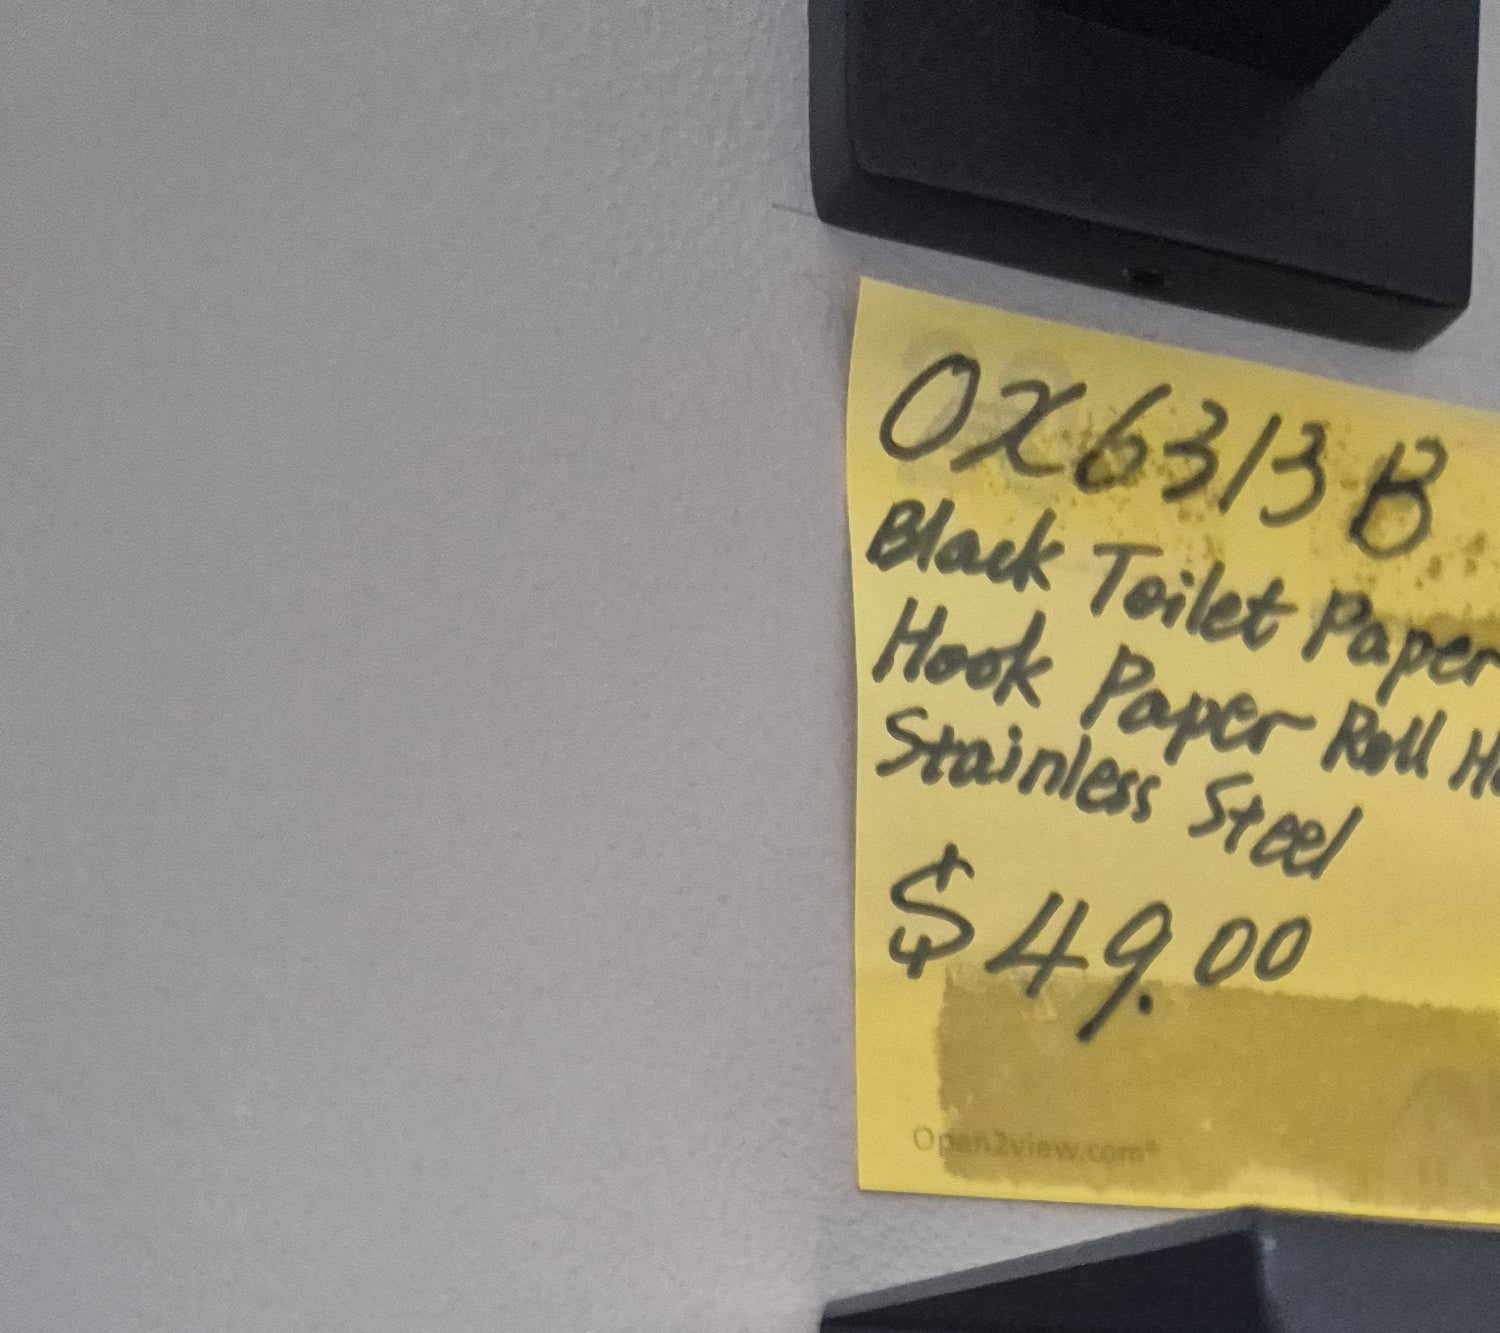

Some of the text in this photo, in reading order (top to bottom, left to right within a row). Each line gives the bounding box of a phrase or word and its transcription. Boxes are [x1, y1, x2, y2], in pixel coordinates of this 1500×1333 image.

[866, 498, 1065, 593] Black
[1090, 542, 1299, 650] Toilet
[871, 597, 1053, 708] Hook
[1080, 644, 1316, 765] Paper
[1321, 699, 1447, 779] Roll
[875, 706, 1363, 880] Stainless Steel
